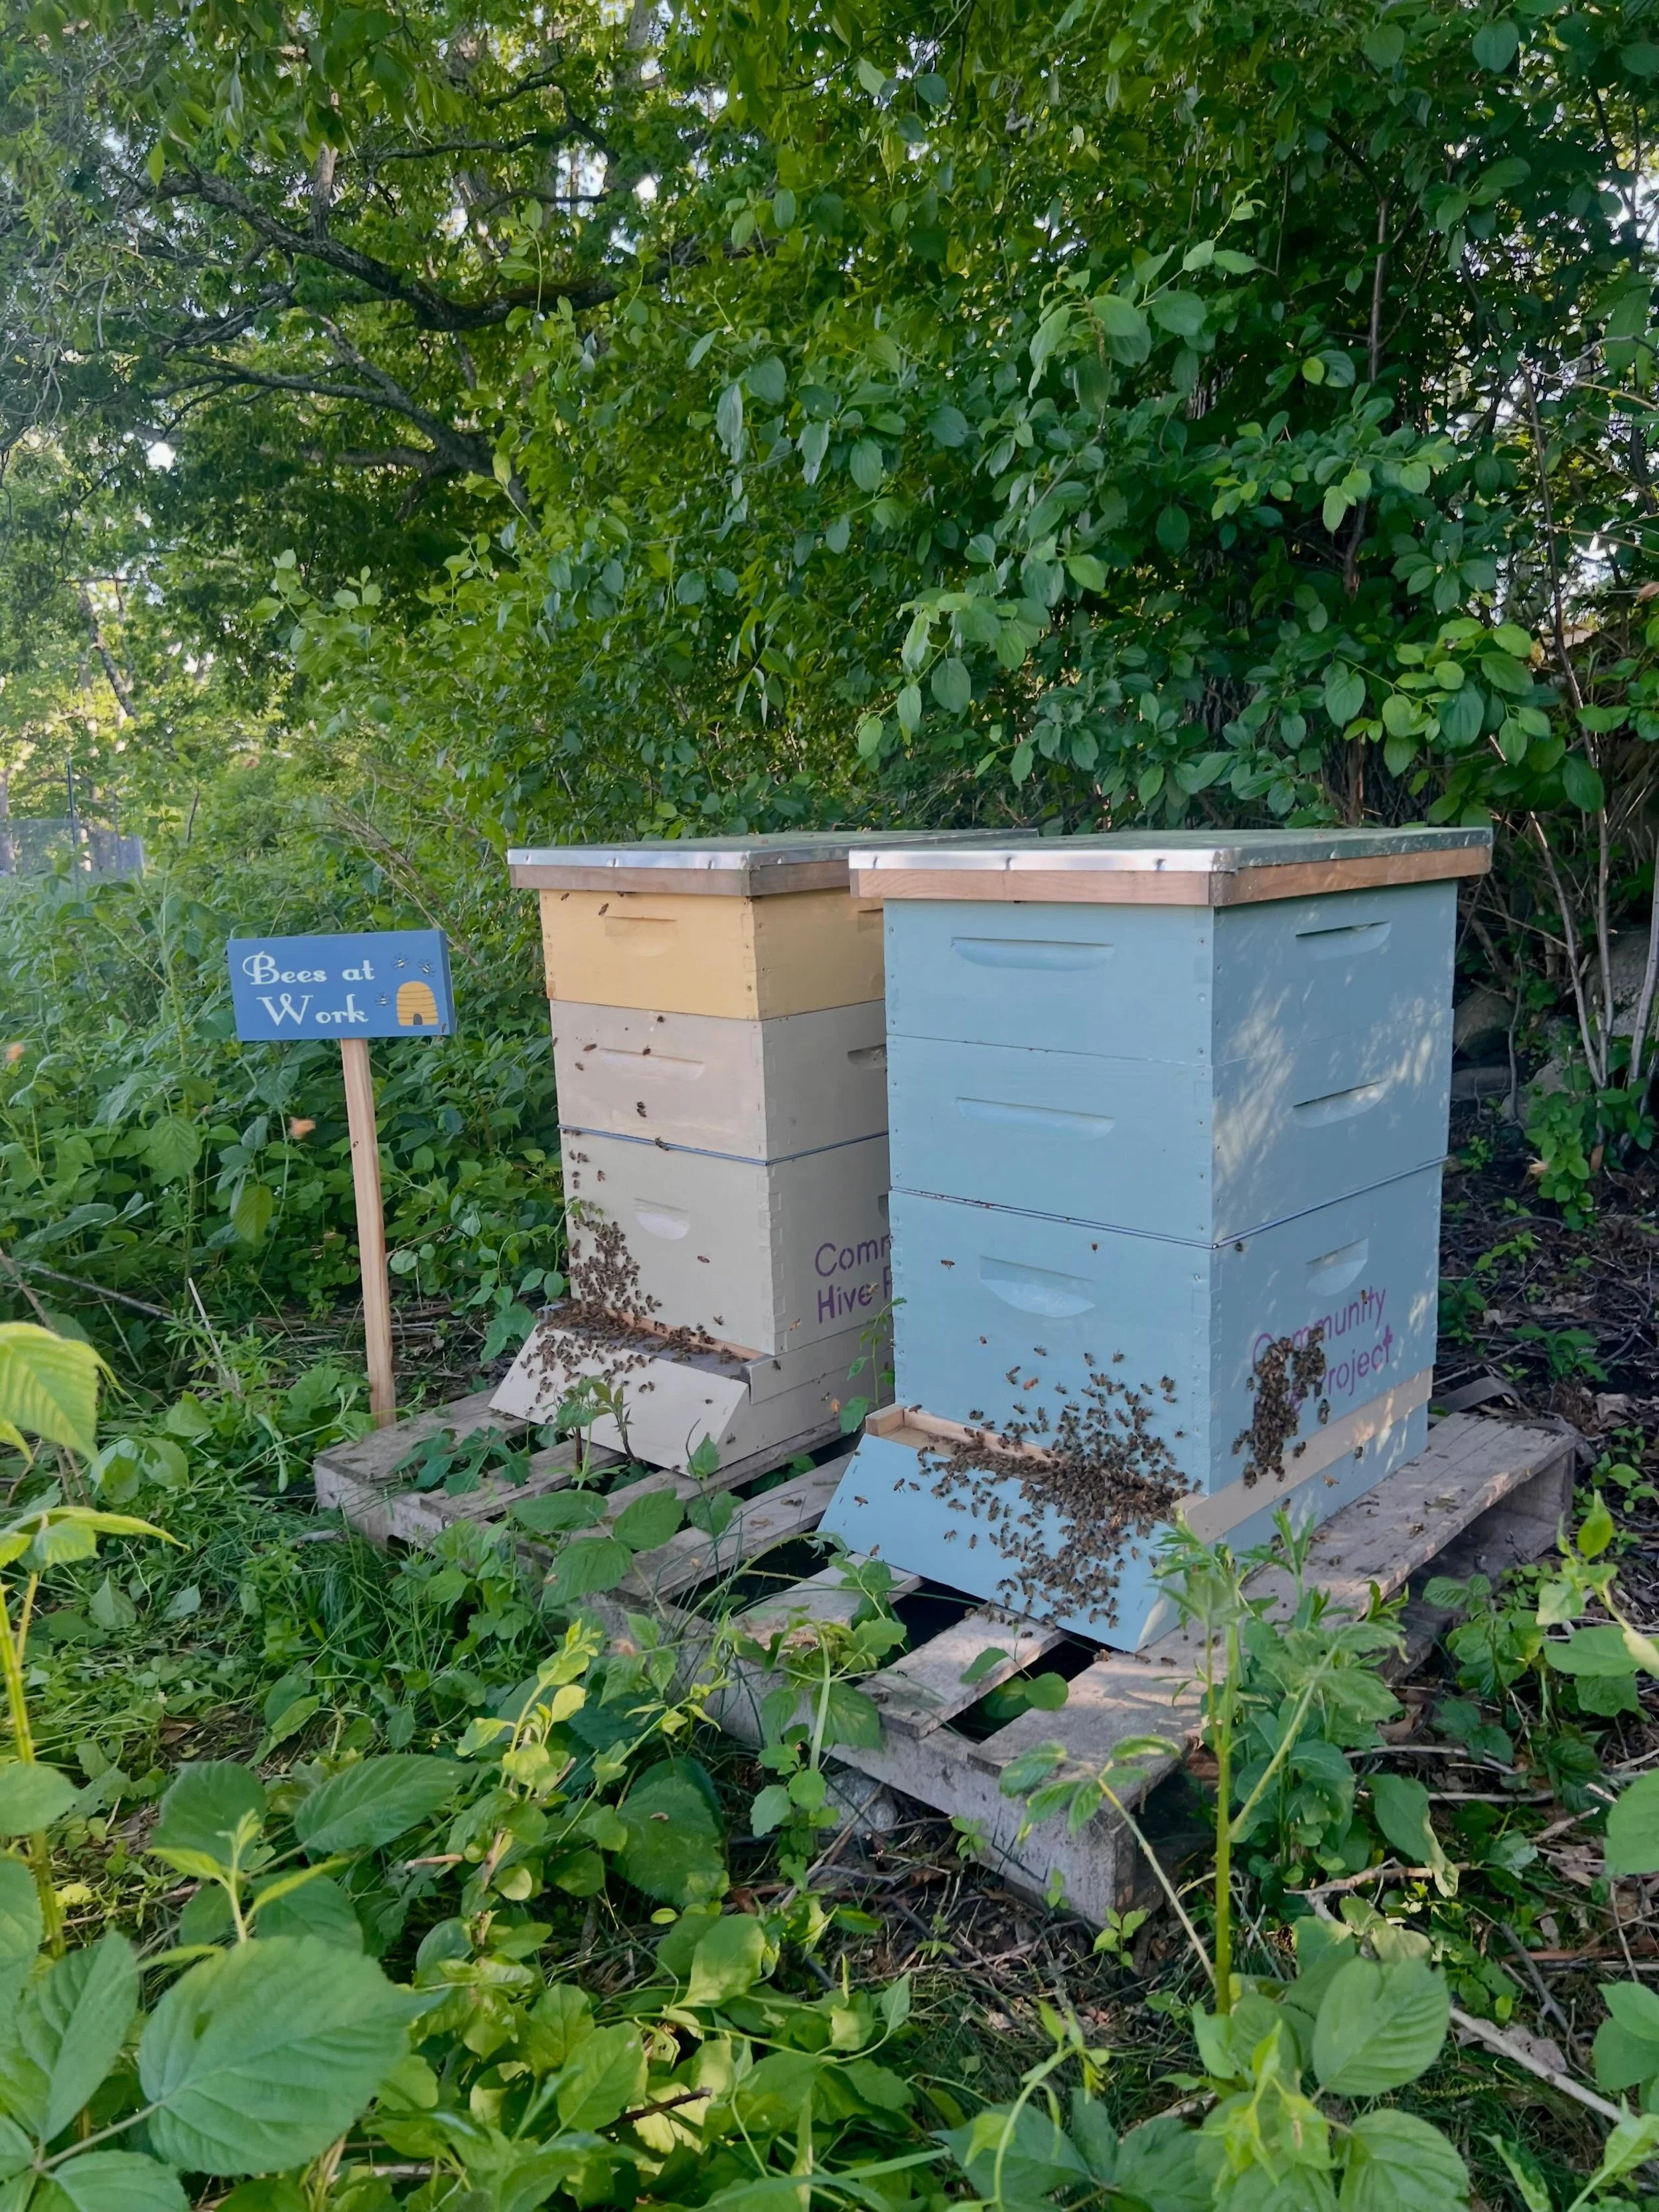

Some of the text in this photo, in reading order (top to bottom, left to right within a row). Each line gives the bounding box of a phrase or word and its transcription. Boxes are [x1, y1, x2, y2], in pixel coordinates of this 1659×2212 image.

[242, 951, 376, 985] Bees at
[256, 993, 370, 1026] Work
[818, 1284, 873, 1324] Hive
